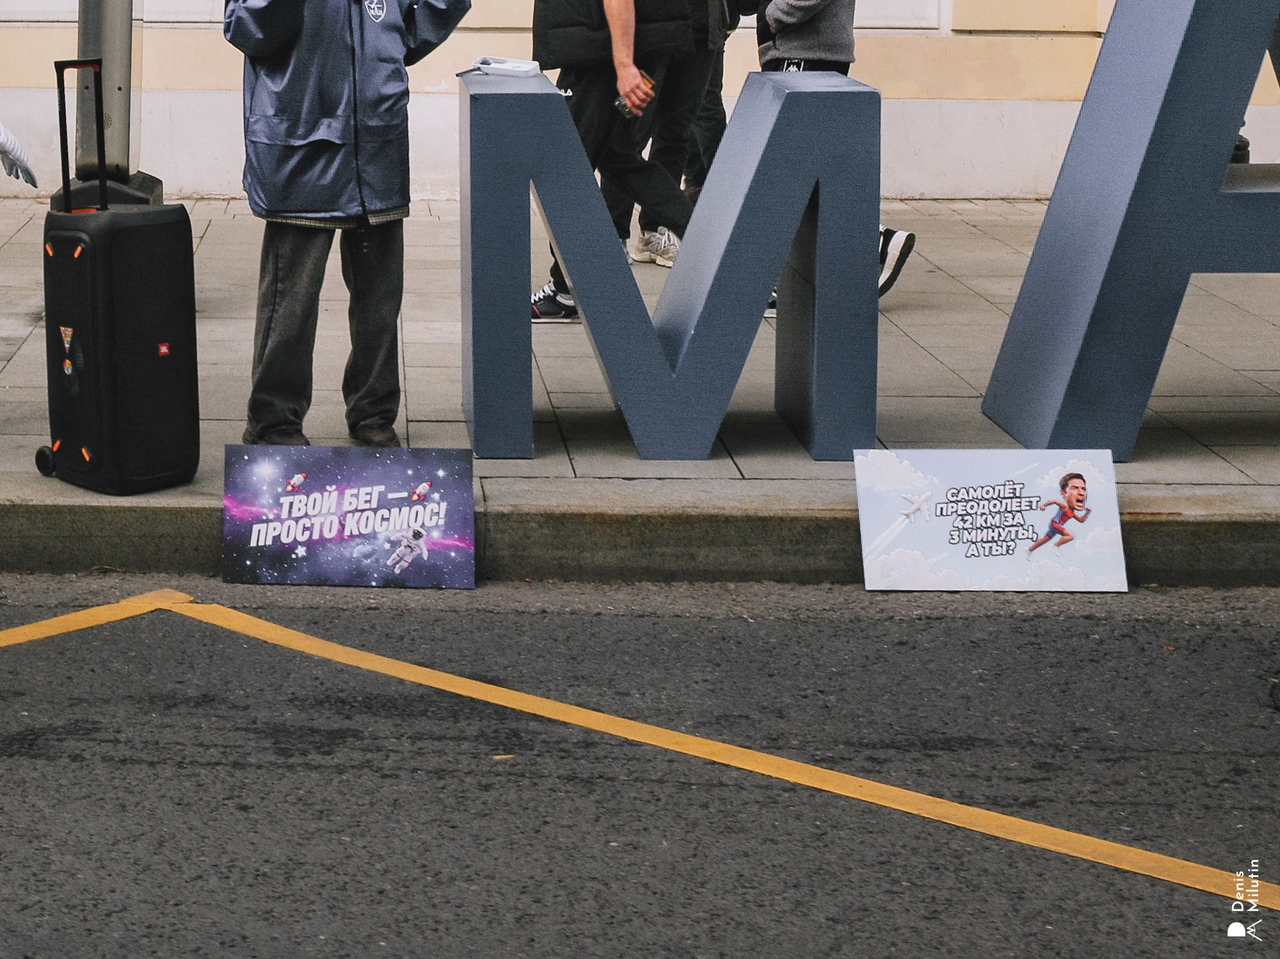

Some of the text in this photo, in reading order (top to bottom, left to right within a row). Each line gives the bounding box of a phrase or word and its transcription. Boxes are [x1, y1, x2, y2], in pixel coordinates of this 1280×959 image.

[946, 480, 1024, 501] САМОЛЁТ
[279, 484, 338, 519] ТВОЙ
[342, 485, 386, 513] БЕГ
[935, 496, 1041, 517] ПРЕОДОЛЕЕТ
[250, 501, 448, 547] ПРОСТО КОСМОС!
[953, 513, 1026, 530] 42 КМ ЗА
[949, 526, 1038, 545] 3 МИНУТЫ,
[966, 540, 1017, 558] А ТЫ?
